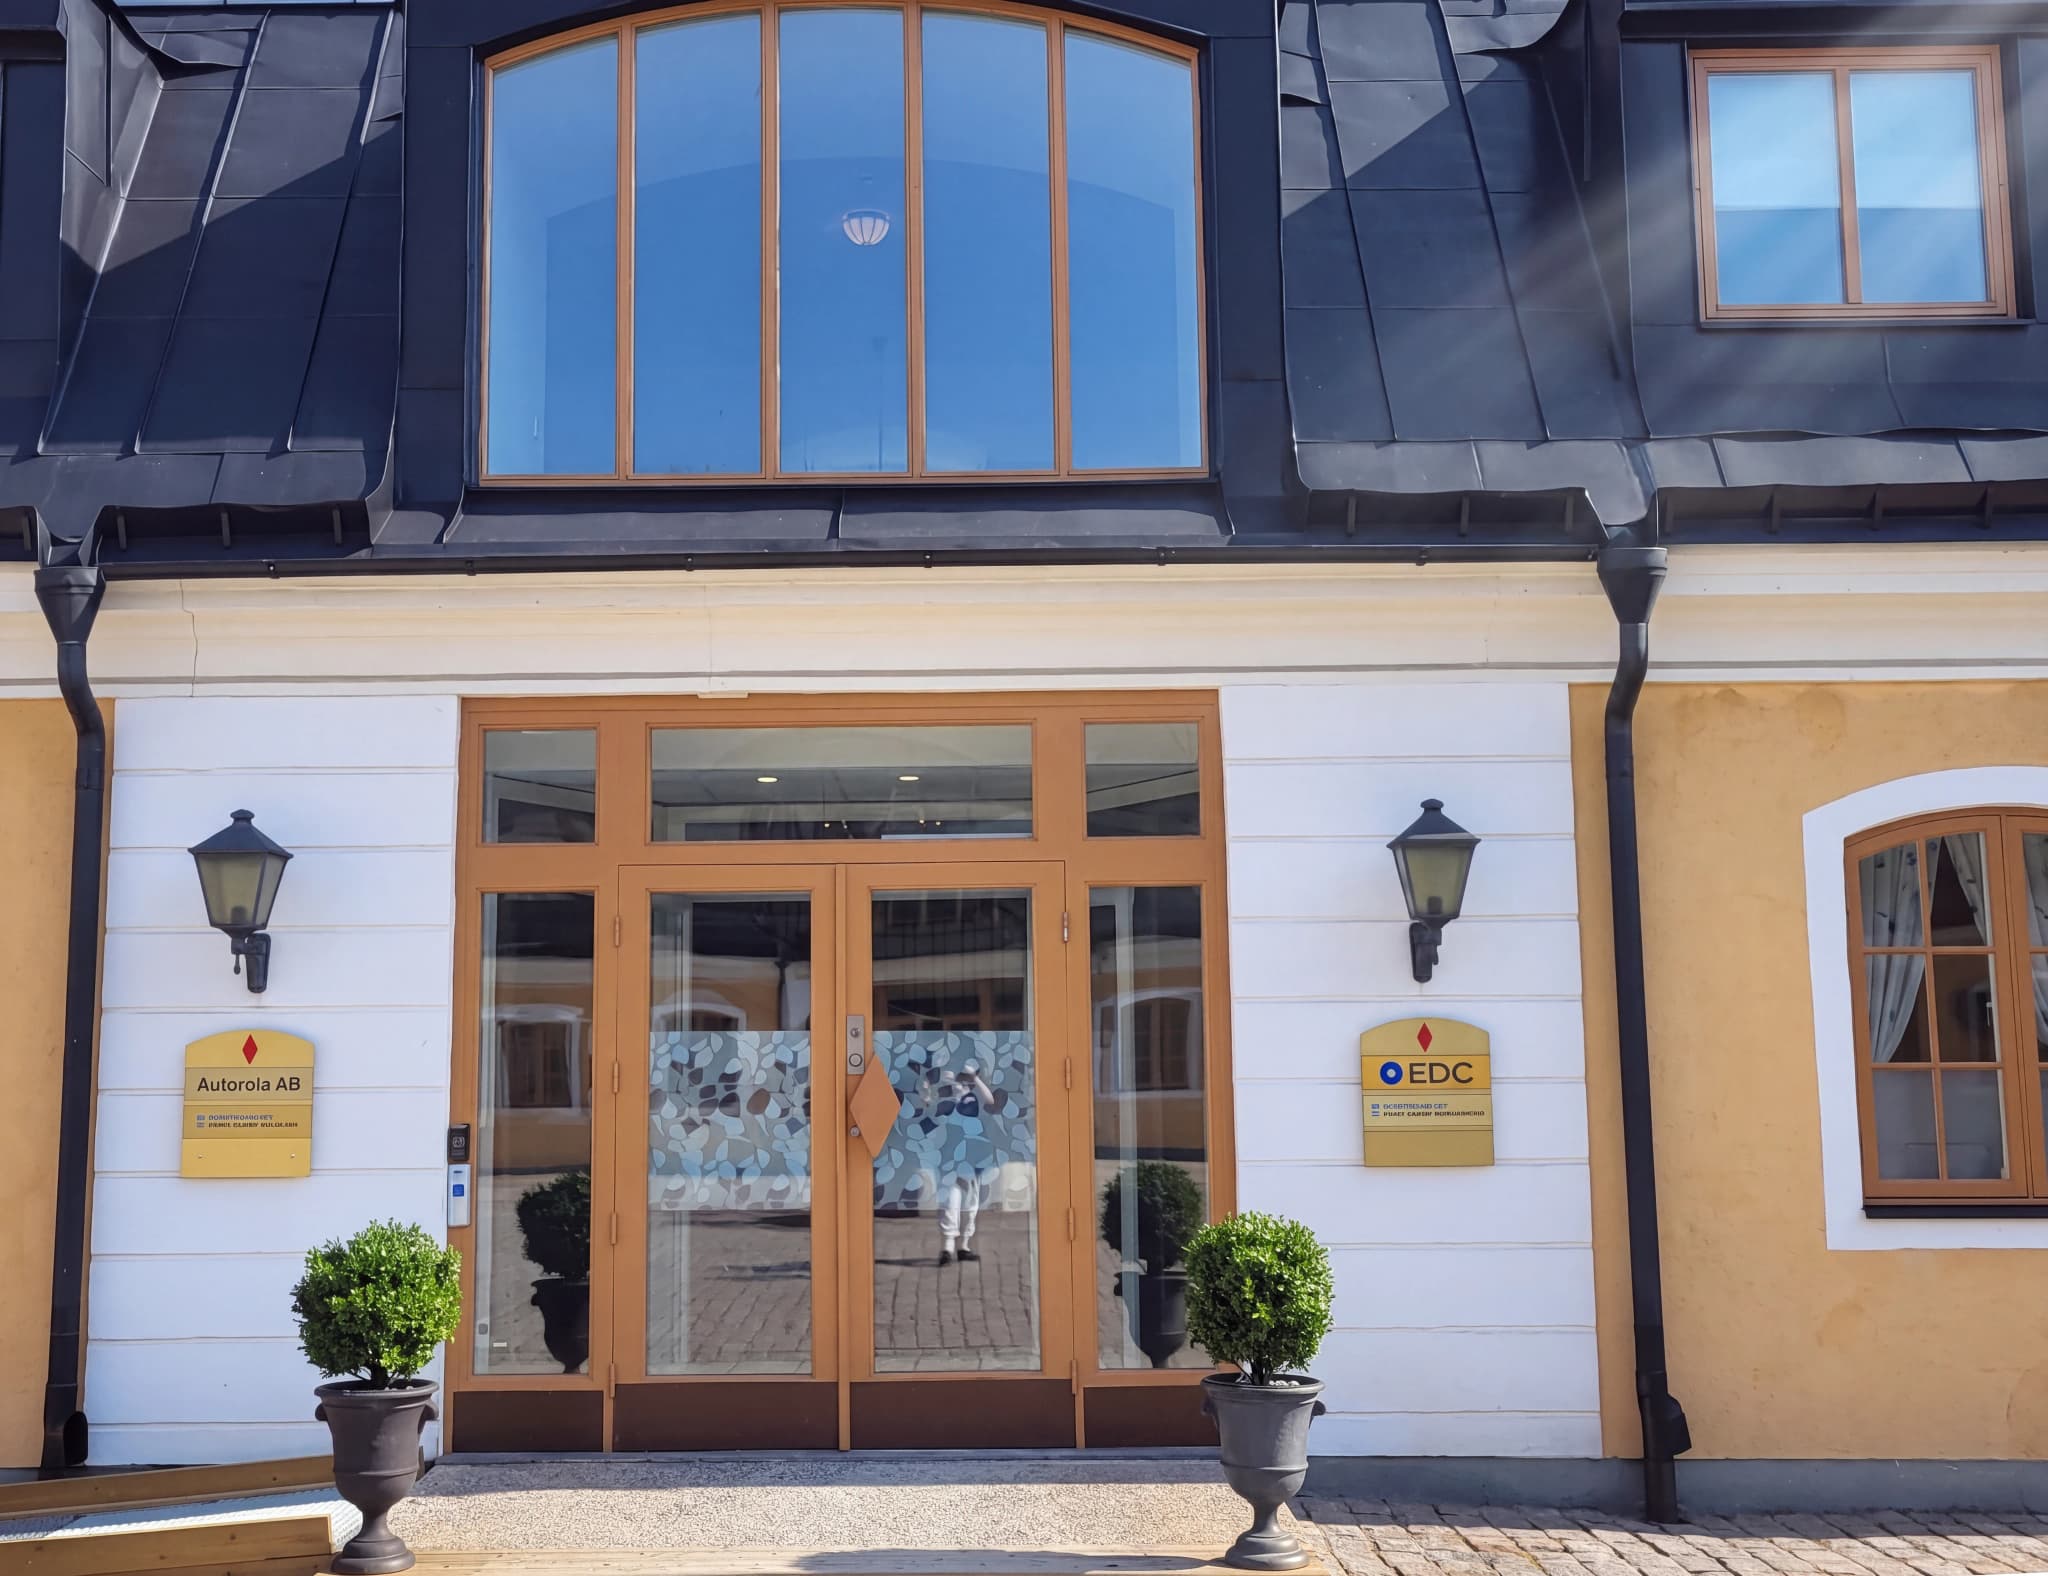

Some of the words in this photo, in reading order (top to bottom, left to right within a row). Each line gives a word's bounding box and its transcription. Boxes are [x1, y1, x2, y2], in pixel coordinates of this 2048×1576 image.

[1409, 1061, 1474, 1084] EDC
[197, 1077, 271, 1092] Autorola
[275, 1076, 301, 1091] AB
